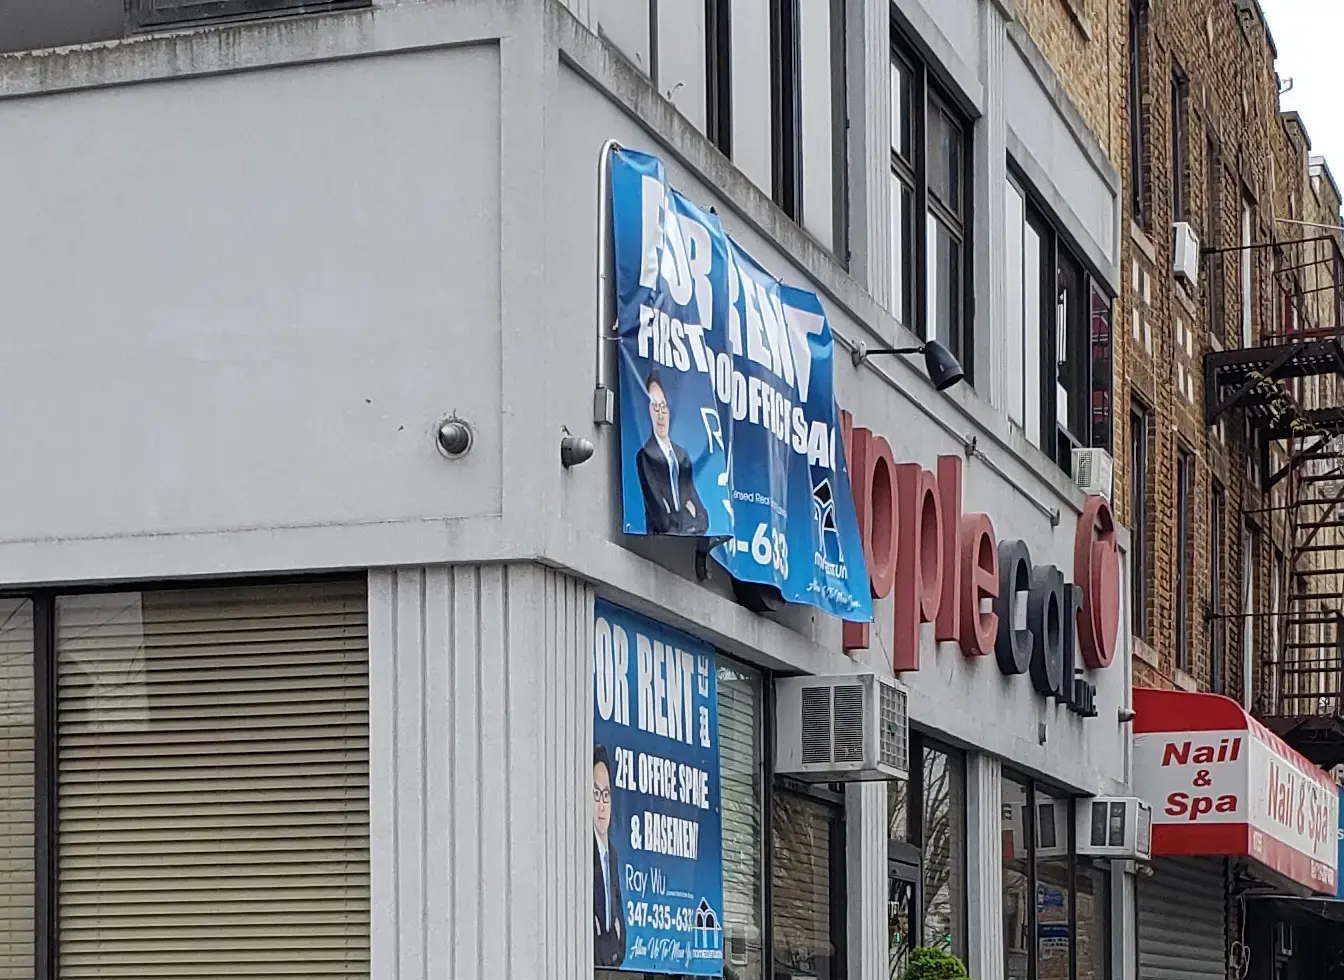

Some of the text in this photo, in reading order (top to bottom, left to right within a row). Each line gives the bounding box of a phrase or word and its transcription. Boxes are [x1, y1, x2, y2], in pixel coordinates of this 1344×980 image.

[638, 304, 708, 373] FIRST
[838, 410, 999, 671] pple
[595, 617, 694, 745] OR RENT
[615, 746, 636, 791] 2FL
[638, 752, 678, 801] OFFICE
[1161, 737, 1242, 767] Nail
[1192, 769, 1212, 787] &
[1164, 792, 1238, 821] Spa
[1268, 759, 1294, 829] Nail
[1308, 786, 1328, 854] Spa
[630, 814, 643, 850] &
[650, 867, 666, 896] Wu
